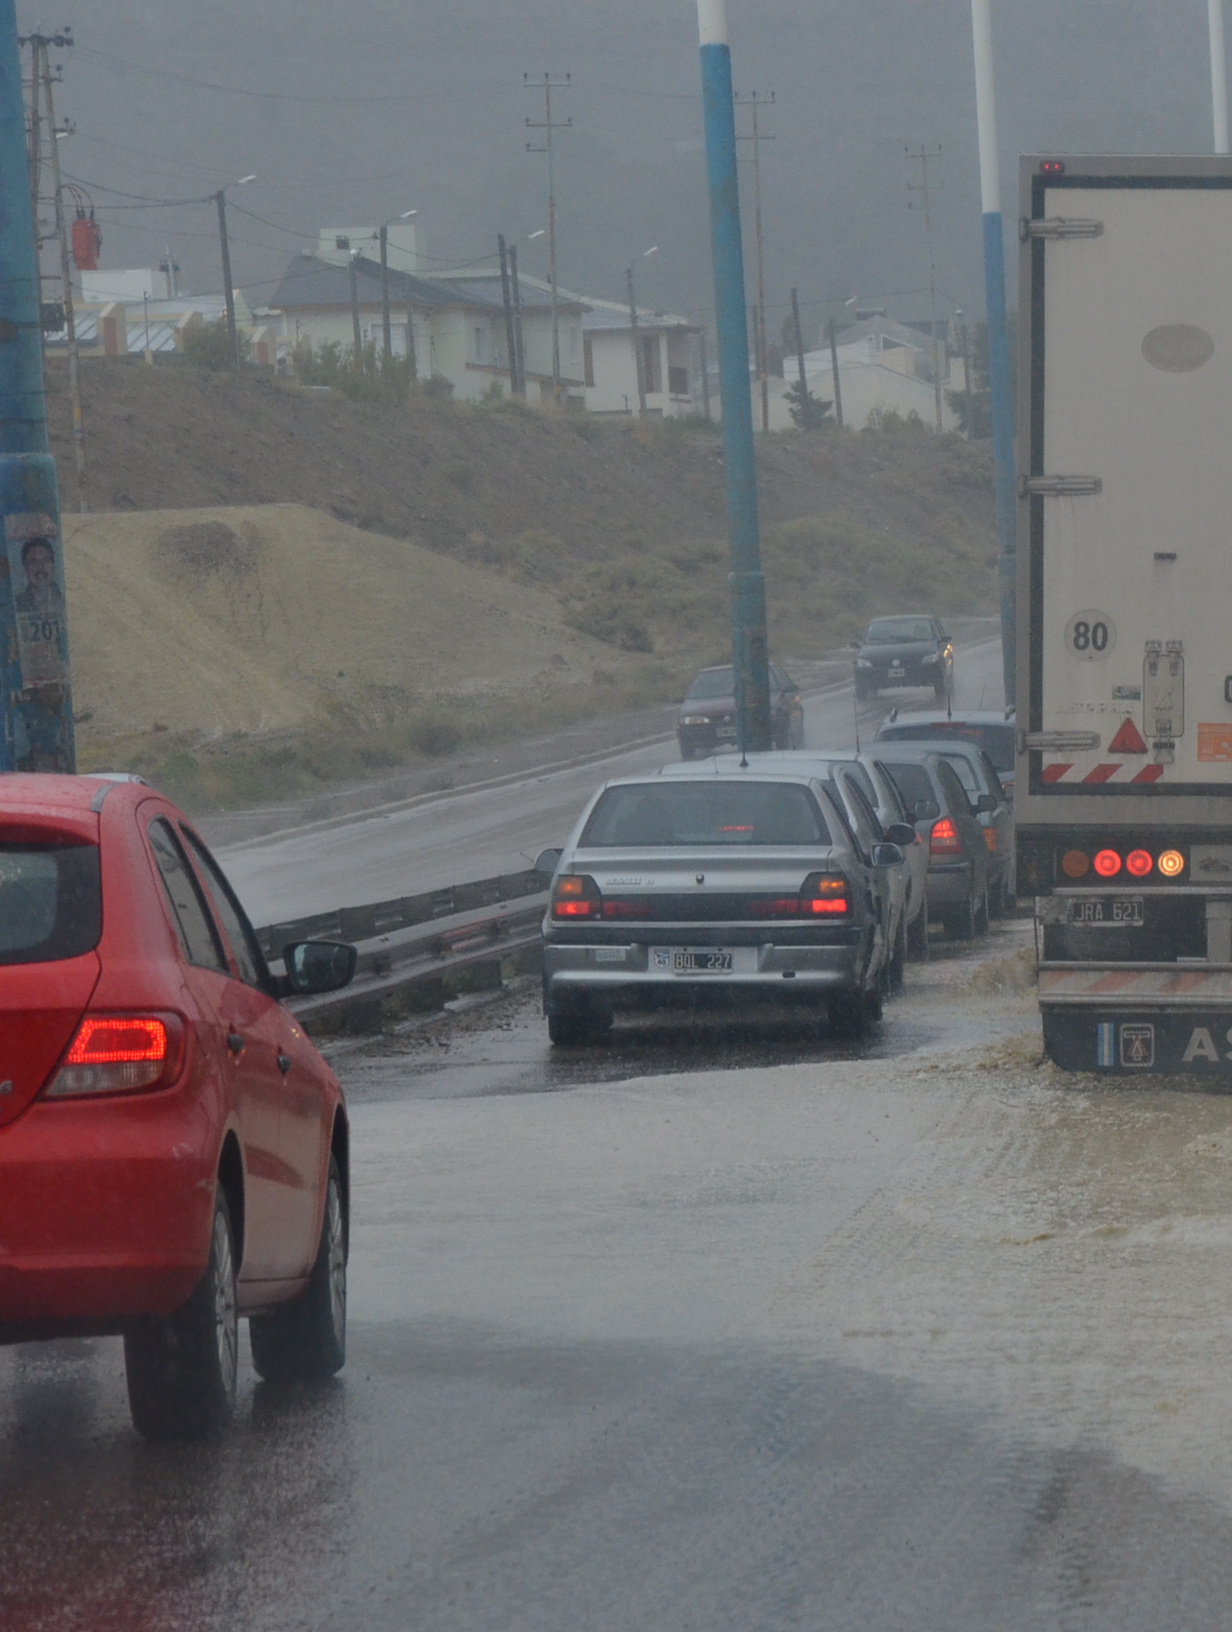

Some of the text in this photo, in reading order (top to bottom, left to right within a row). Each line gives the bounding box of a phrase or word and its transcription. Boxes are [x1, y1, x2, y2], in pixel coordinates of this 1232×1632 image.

[1073, 621, 1108, 651] 80
[1076, 903, 1141, 921] JRA 621
[675, 954, 731, 969] BQL 227
